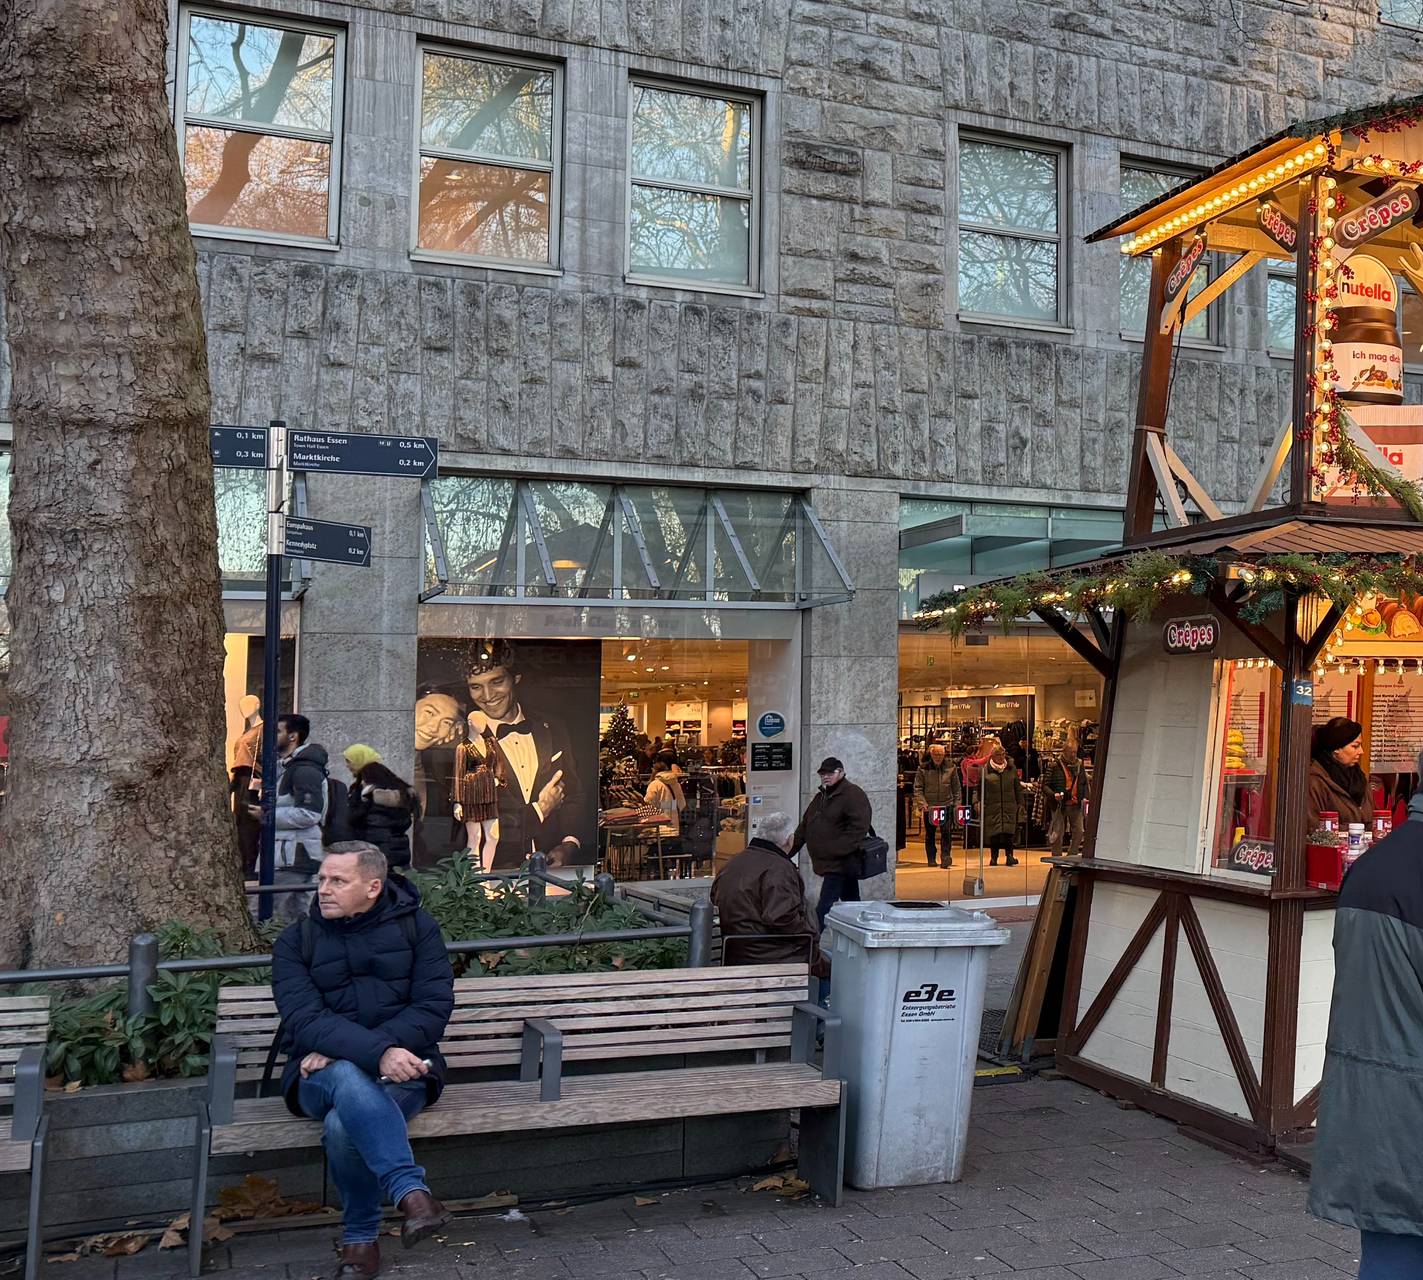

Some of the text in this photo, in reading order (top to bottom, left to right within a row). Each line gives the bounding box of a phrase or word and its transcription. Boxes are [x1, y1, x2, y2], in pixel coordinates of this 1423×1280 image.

[1342, 192, 1412, 240] Crêpes
[1260, 206, 1297, 248] Crêpes
[1167, 240, 1204, 295] Crêpes
[1341, 281, 1391, 302] nutella
[1352, 350, 1366, 359] Ich
[1368, 353, 1387, 363] mag
[252, 432, 264, 440] km
[294, 434, 325, 444] Rathaus
[252, 450, 264, 458] km
[293, 453, 340, 463] Marktkirche
[413, 459, 424, 467] km
[1167, 621, 1214, 650] Crêpes
[1296, 685, 1312, 696] 32
[1234, 844, 1276, 870] Crêpe
[903, 984, 956, 1002] e3e
